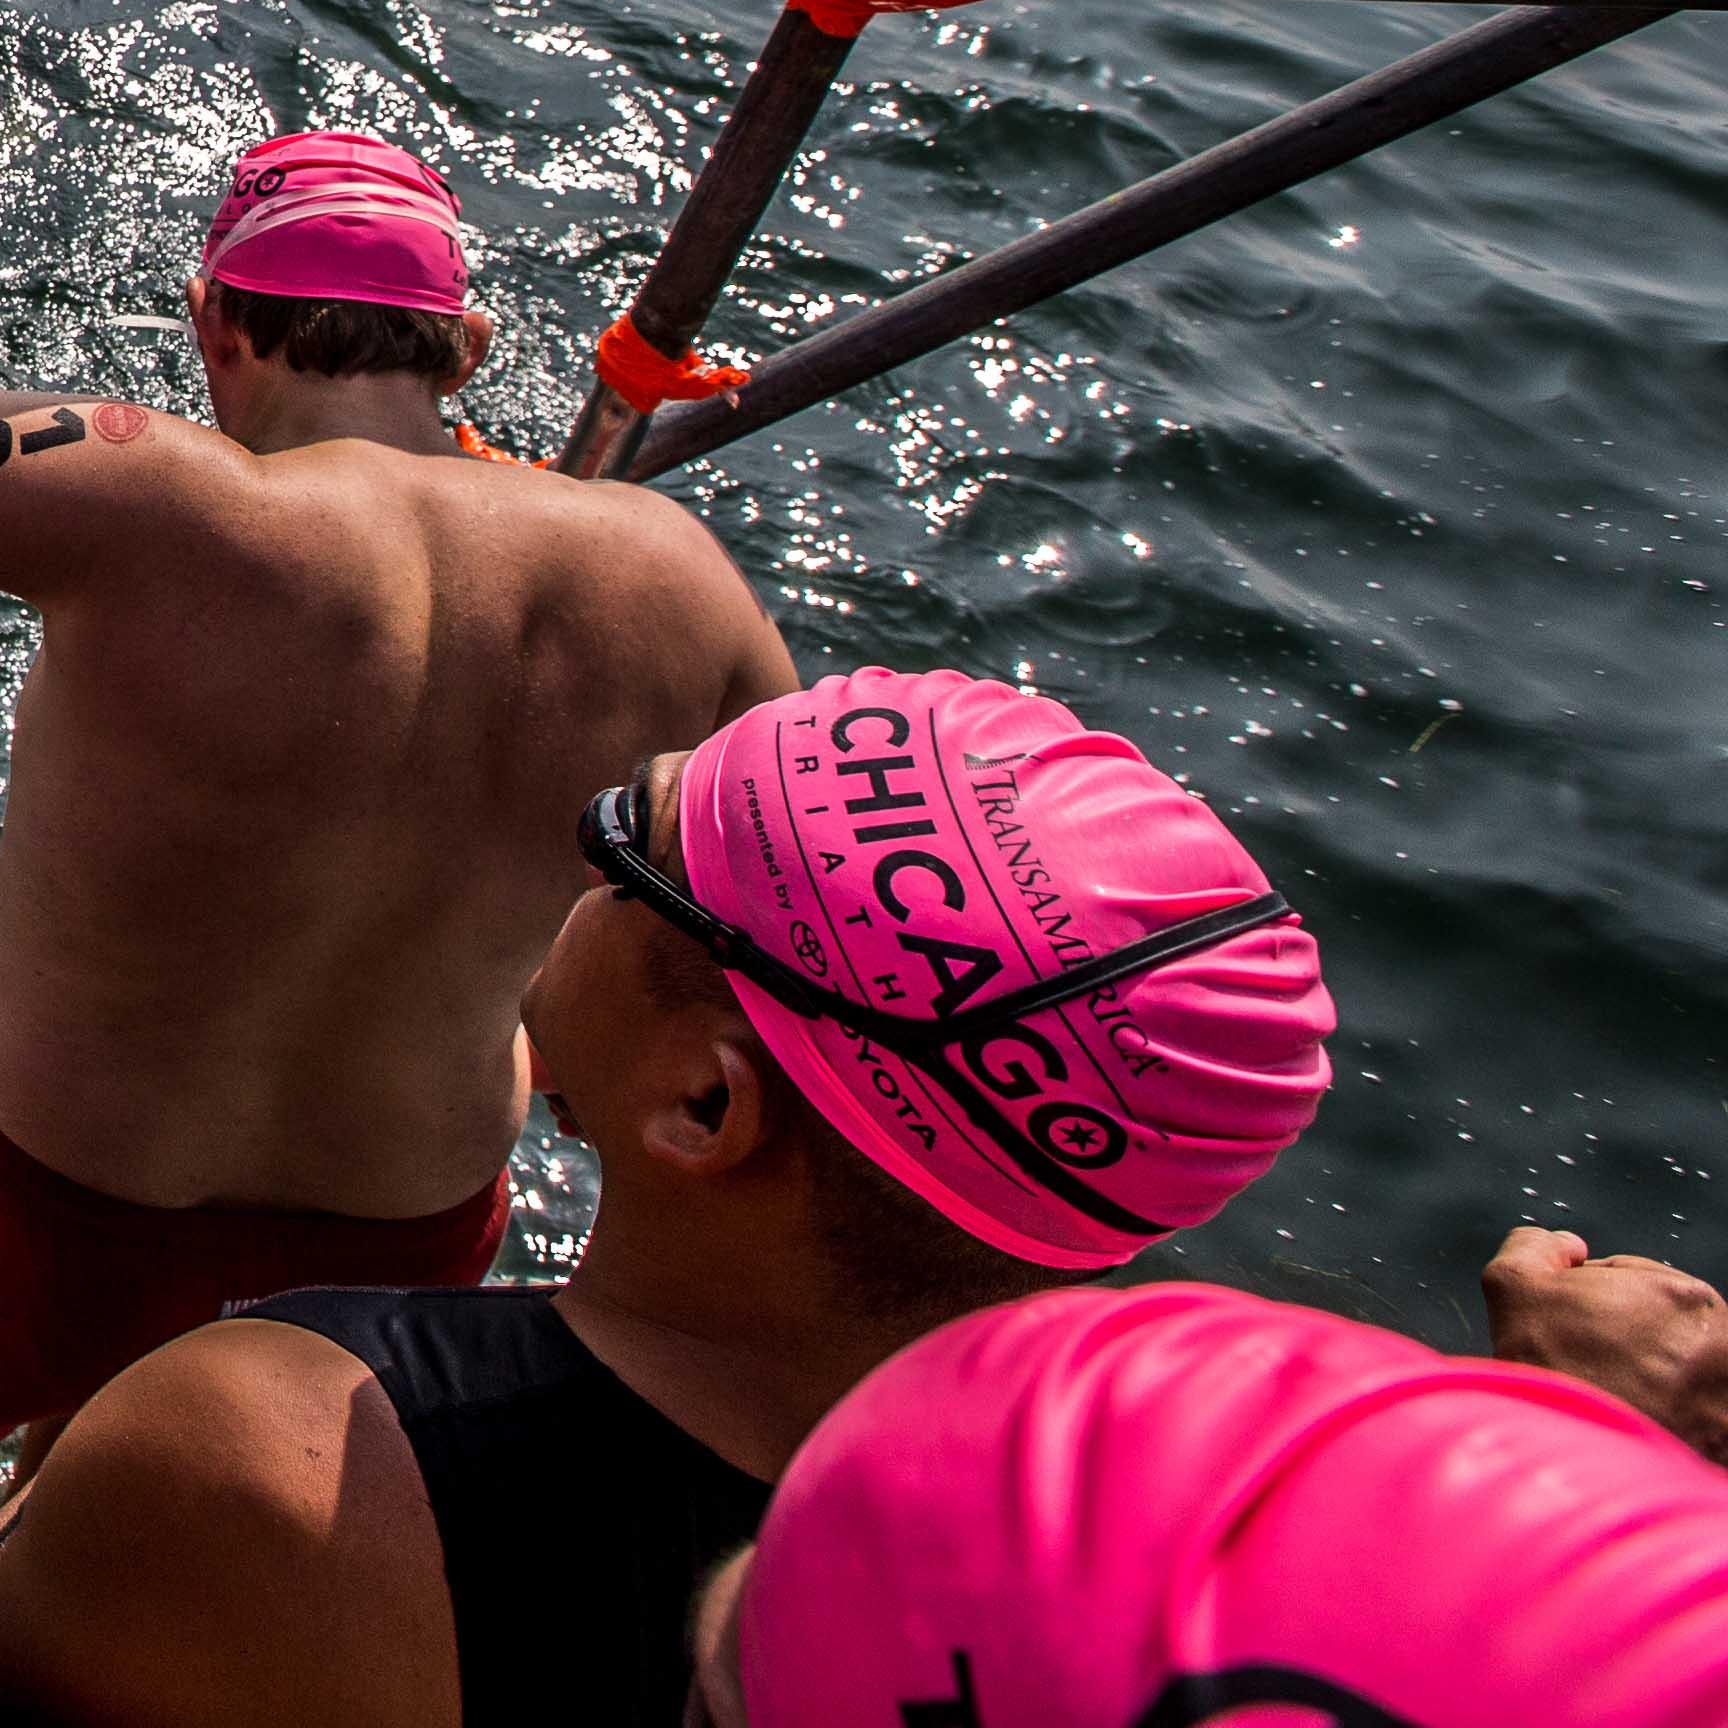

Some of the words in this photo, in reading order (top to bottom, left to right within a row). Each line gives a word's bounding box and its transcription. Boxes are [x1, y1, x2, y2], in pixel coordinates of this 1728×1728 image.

[741, 775, 784, 878] presented
[773, 883, 795, 912] by
[831, 706, 1130, 1171] CHICAGO
[970, 770, 1162, 1079] TRANSAMRICA
